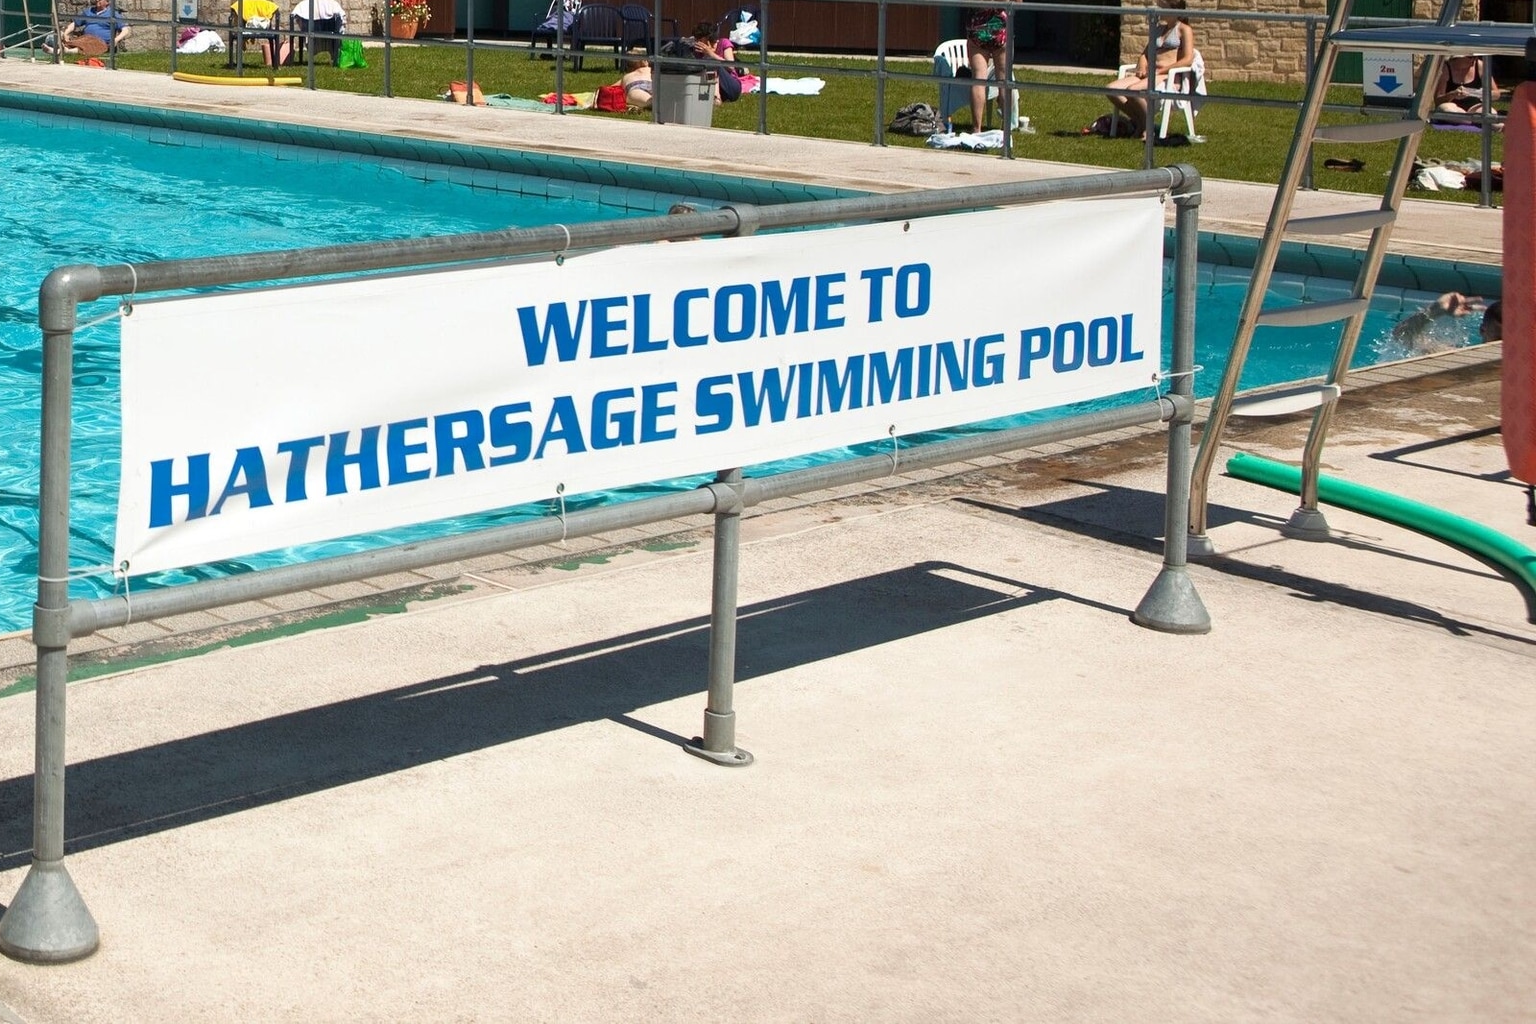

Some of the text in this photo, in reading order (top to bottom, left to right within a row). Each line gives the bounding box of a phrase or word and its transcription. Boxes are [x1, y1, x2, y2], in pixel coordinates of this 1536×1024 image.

[1379, 64, 1396, 73] 2m
[517, 262, 932, 367] WELCOME TO
[149, 313, 1145, 529] HATHERSAGE SWIMMING POOL
